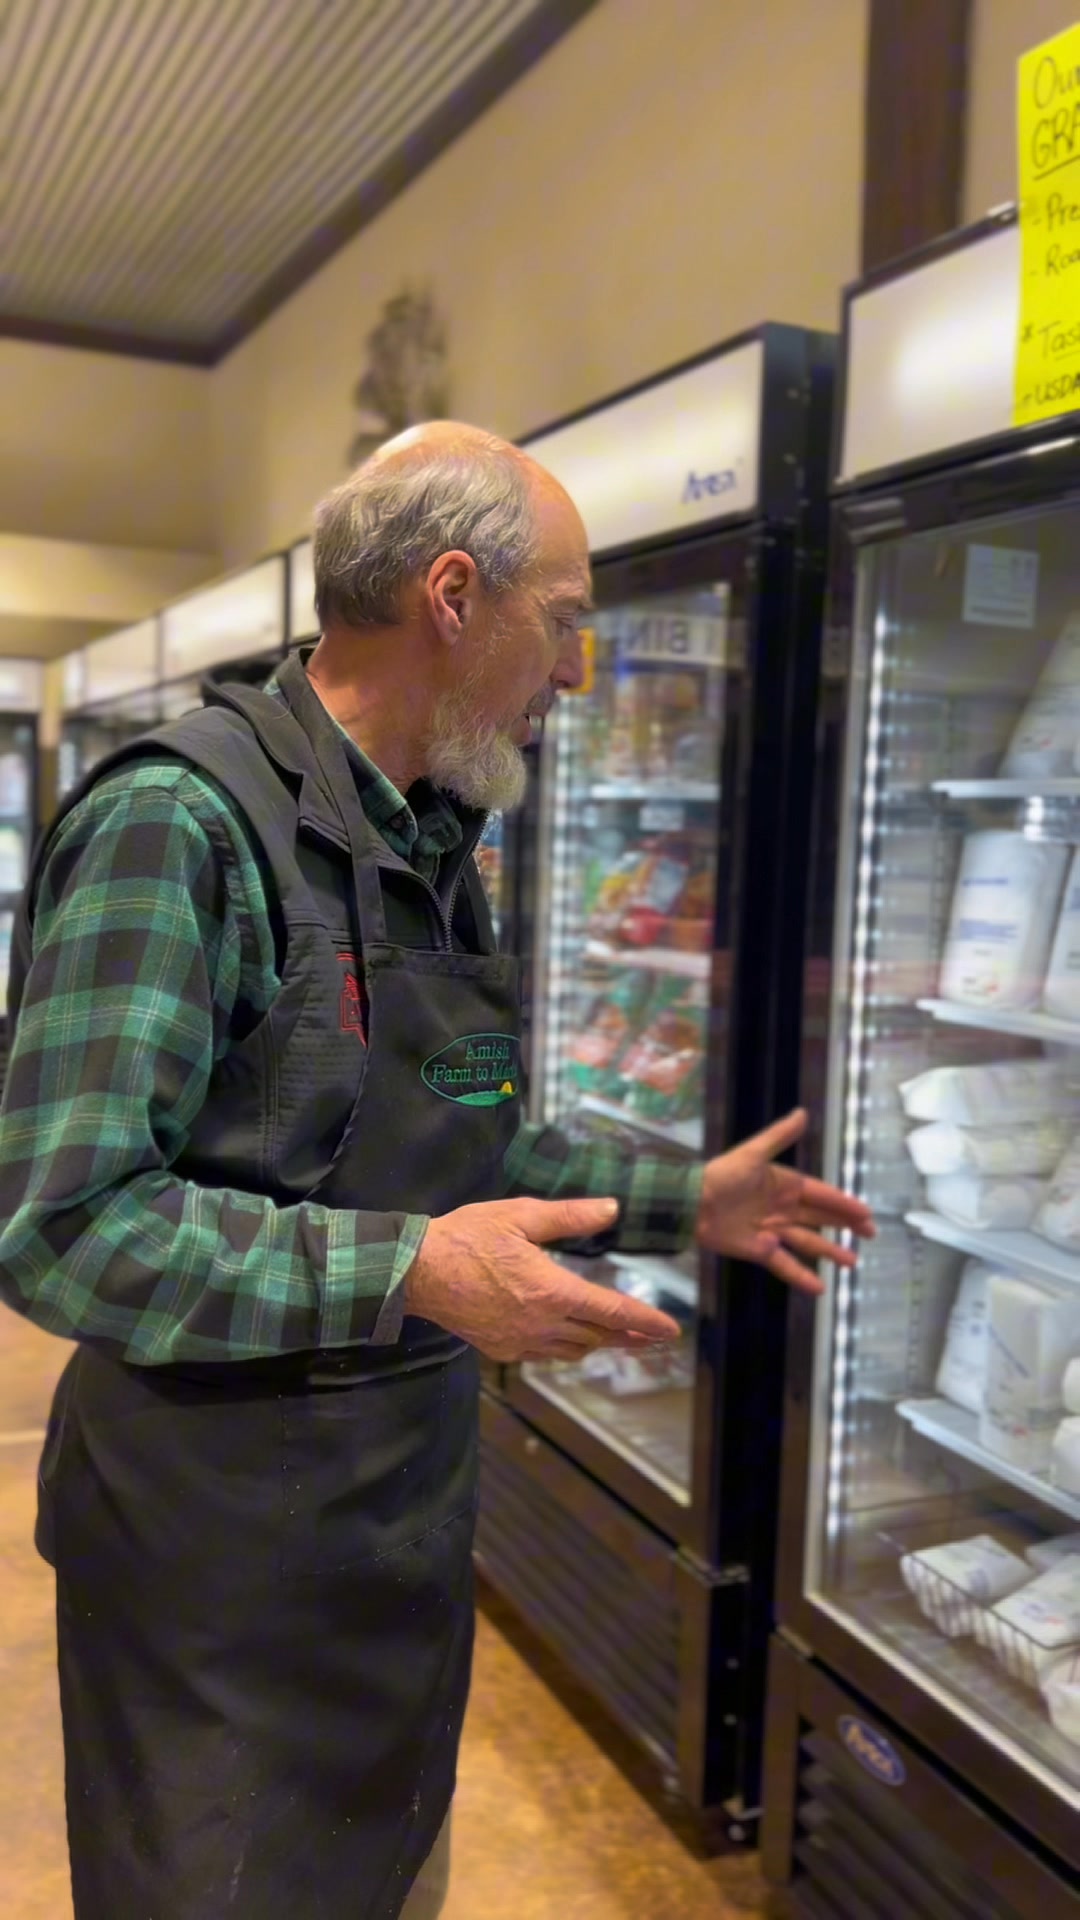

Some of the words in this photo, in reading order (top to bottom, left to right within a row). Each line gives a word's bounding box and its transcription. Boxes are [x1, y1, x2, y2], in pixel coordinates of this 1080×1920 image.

[465, 1041, 510, 1061] Amish
[431, 1064, 472, 1083] Farm
[475, 1065, 489, 1081] to
